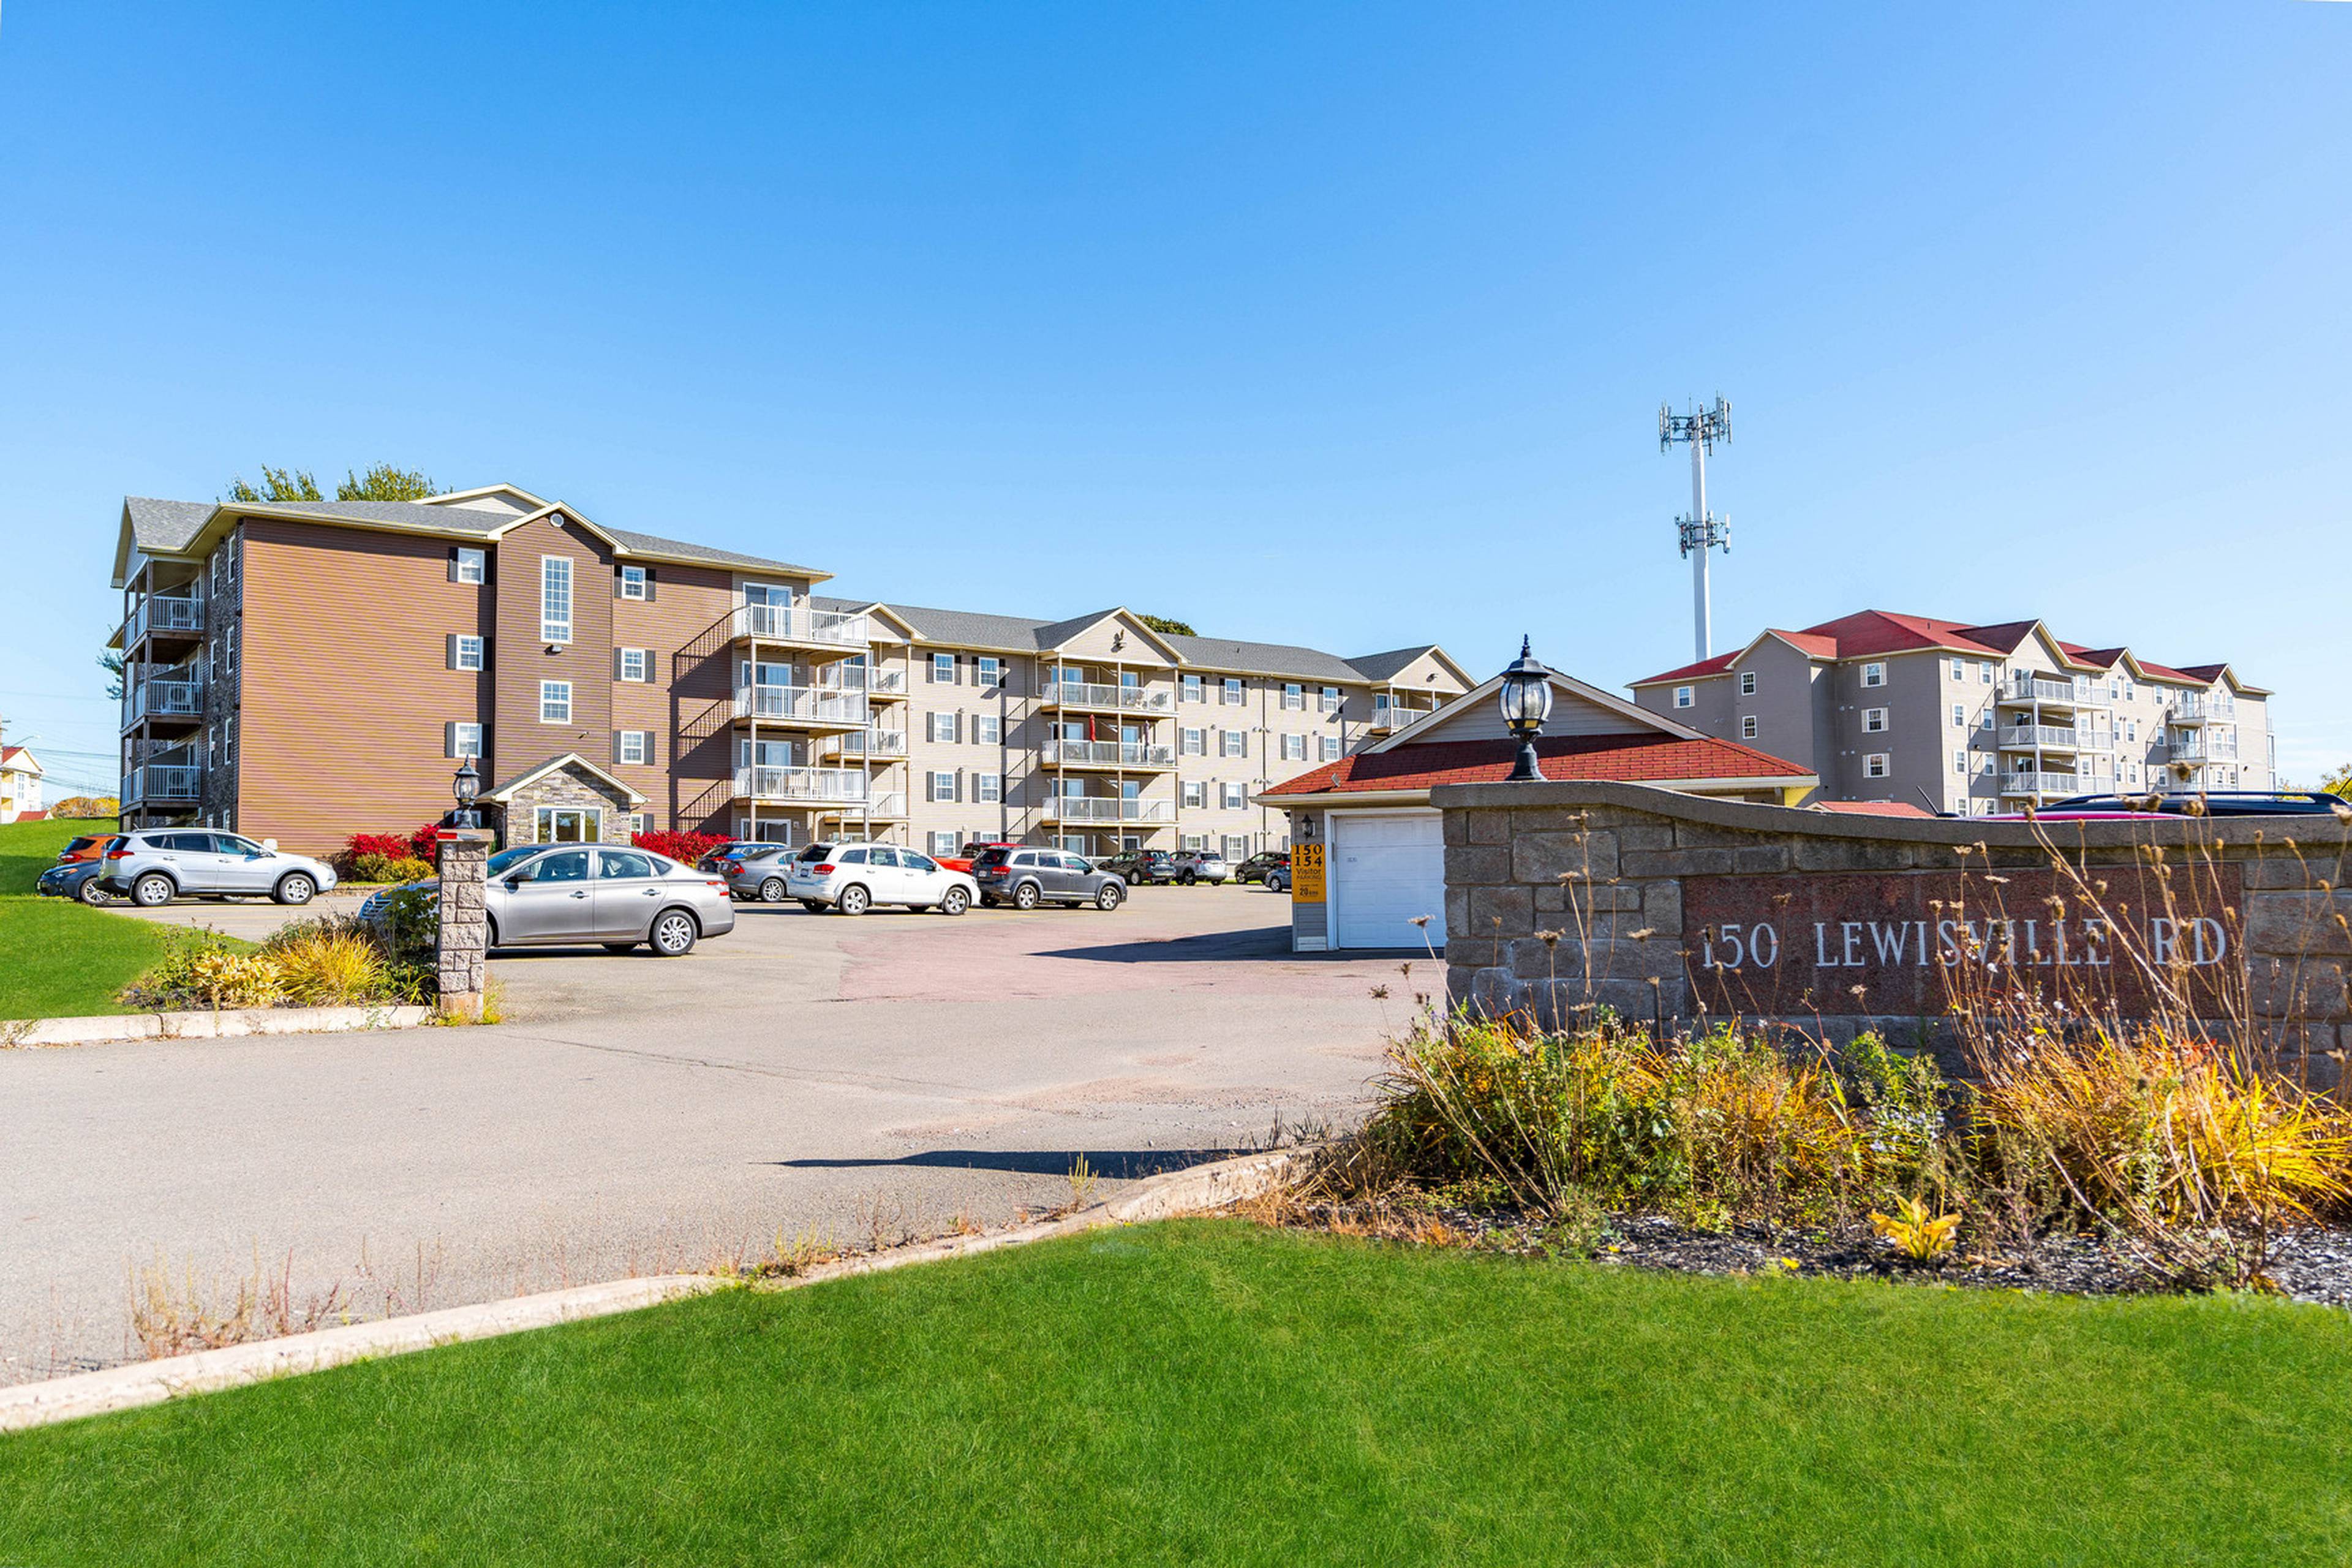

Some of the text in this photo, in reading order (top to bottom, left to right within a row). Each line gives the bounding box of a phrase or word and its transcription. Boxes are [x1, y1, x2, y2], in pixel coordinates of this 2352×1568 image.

[1295, 844, 1322, 855] 150
[1295, 856, 1322, 867] 154
[1703, 917, 2226, 968] 150 LEWISVILLE RD
